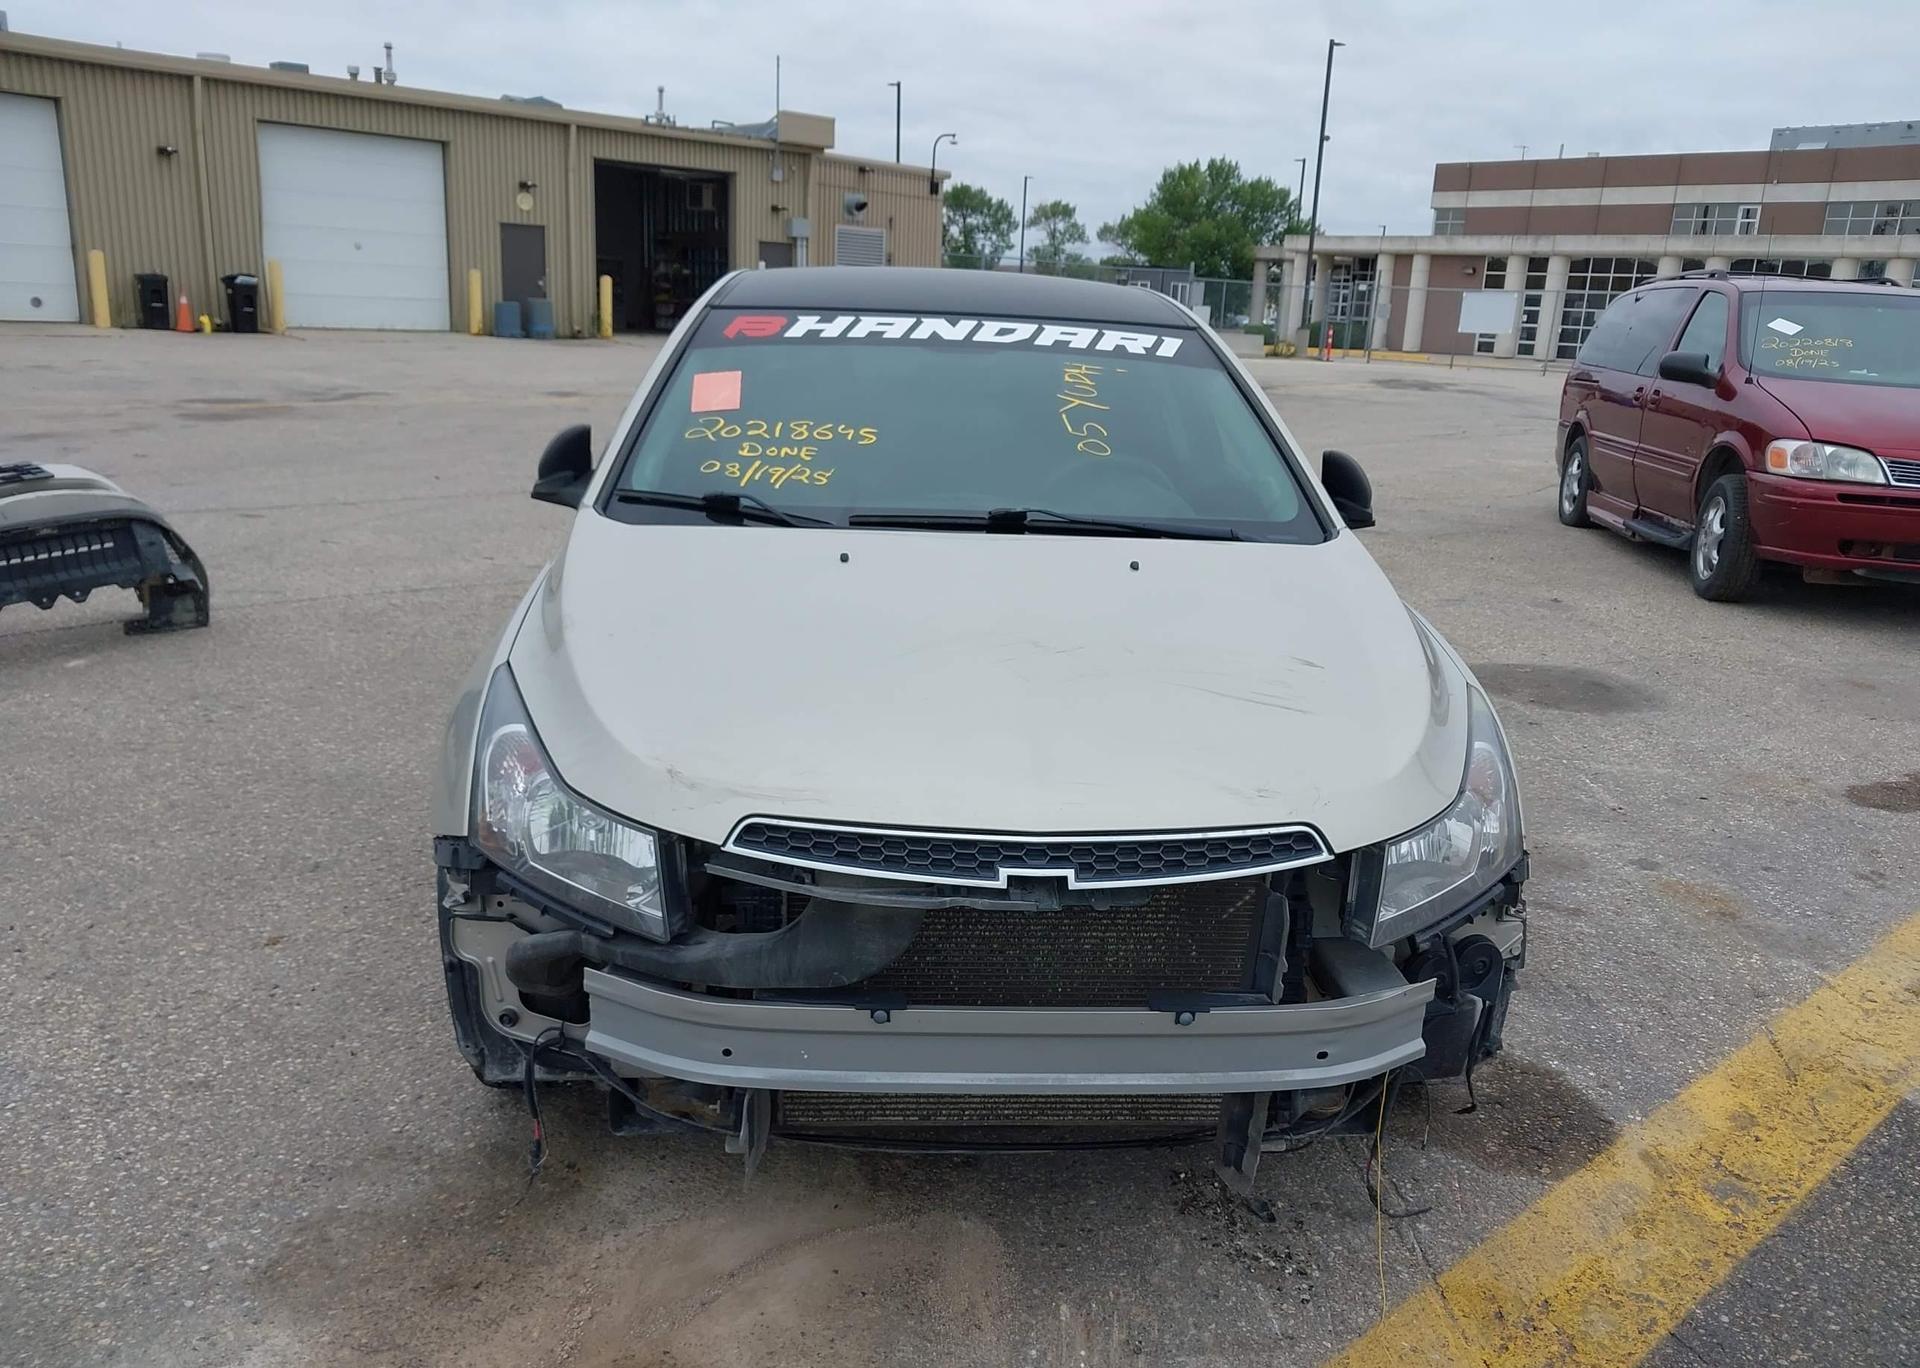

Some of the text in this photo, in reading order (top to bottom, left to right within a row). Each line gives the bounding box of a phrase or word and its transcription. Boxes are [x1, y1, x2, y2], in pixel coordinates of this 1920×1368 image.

[1790, 347, 1829, 357] DONE
[684, 416, 879, 445] 20218645
[738, 441, 819, 460] DONE
